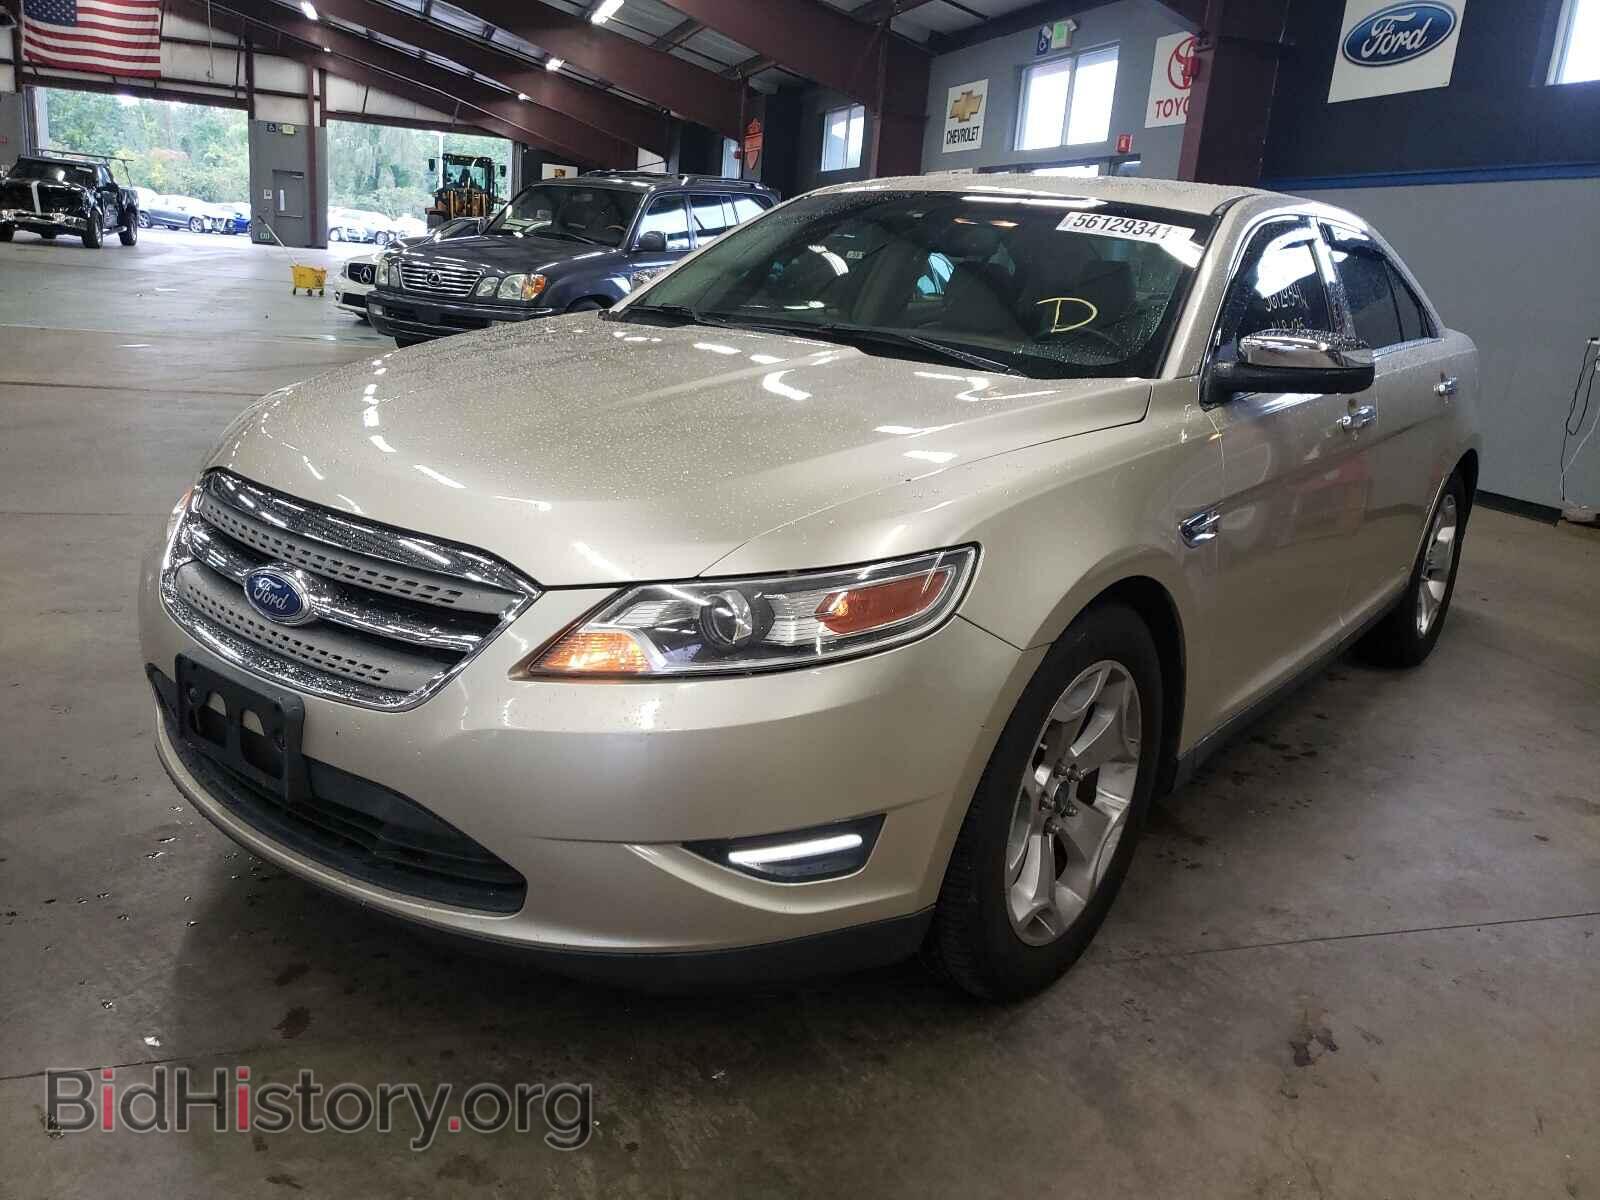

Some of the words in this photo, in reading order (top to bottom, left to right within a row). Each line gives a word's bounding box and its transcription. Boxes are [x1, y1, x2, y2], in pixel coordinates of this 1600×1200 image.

[1361, 12, 1433, 58] Ford
[946, 126, 980, 145] CHEVROLET
[1036, 297, 1098, 333] D
[254, 577, 290, 610] Ford
